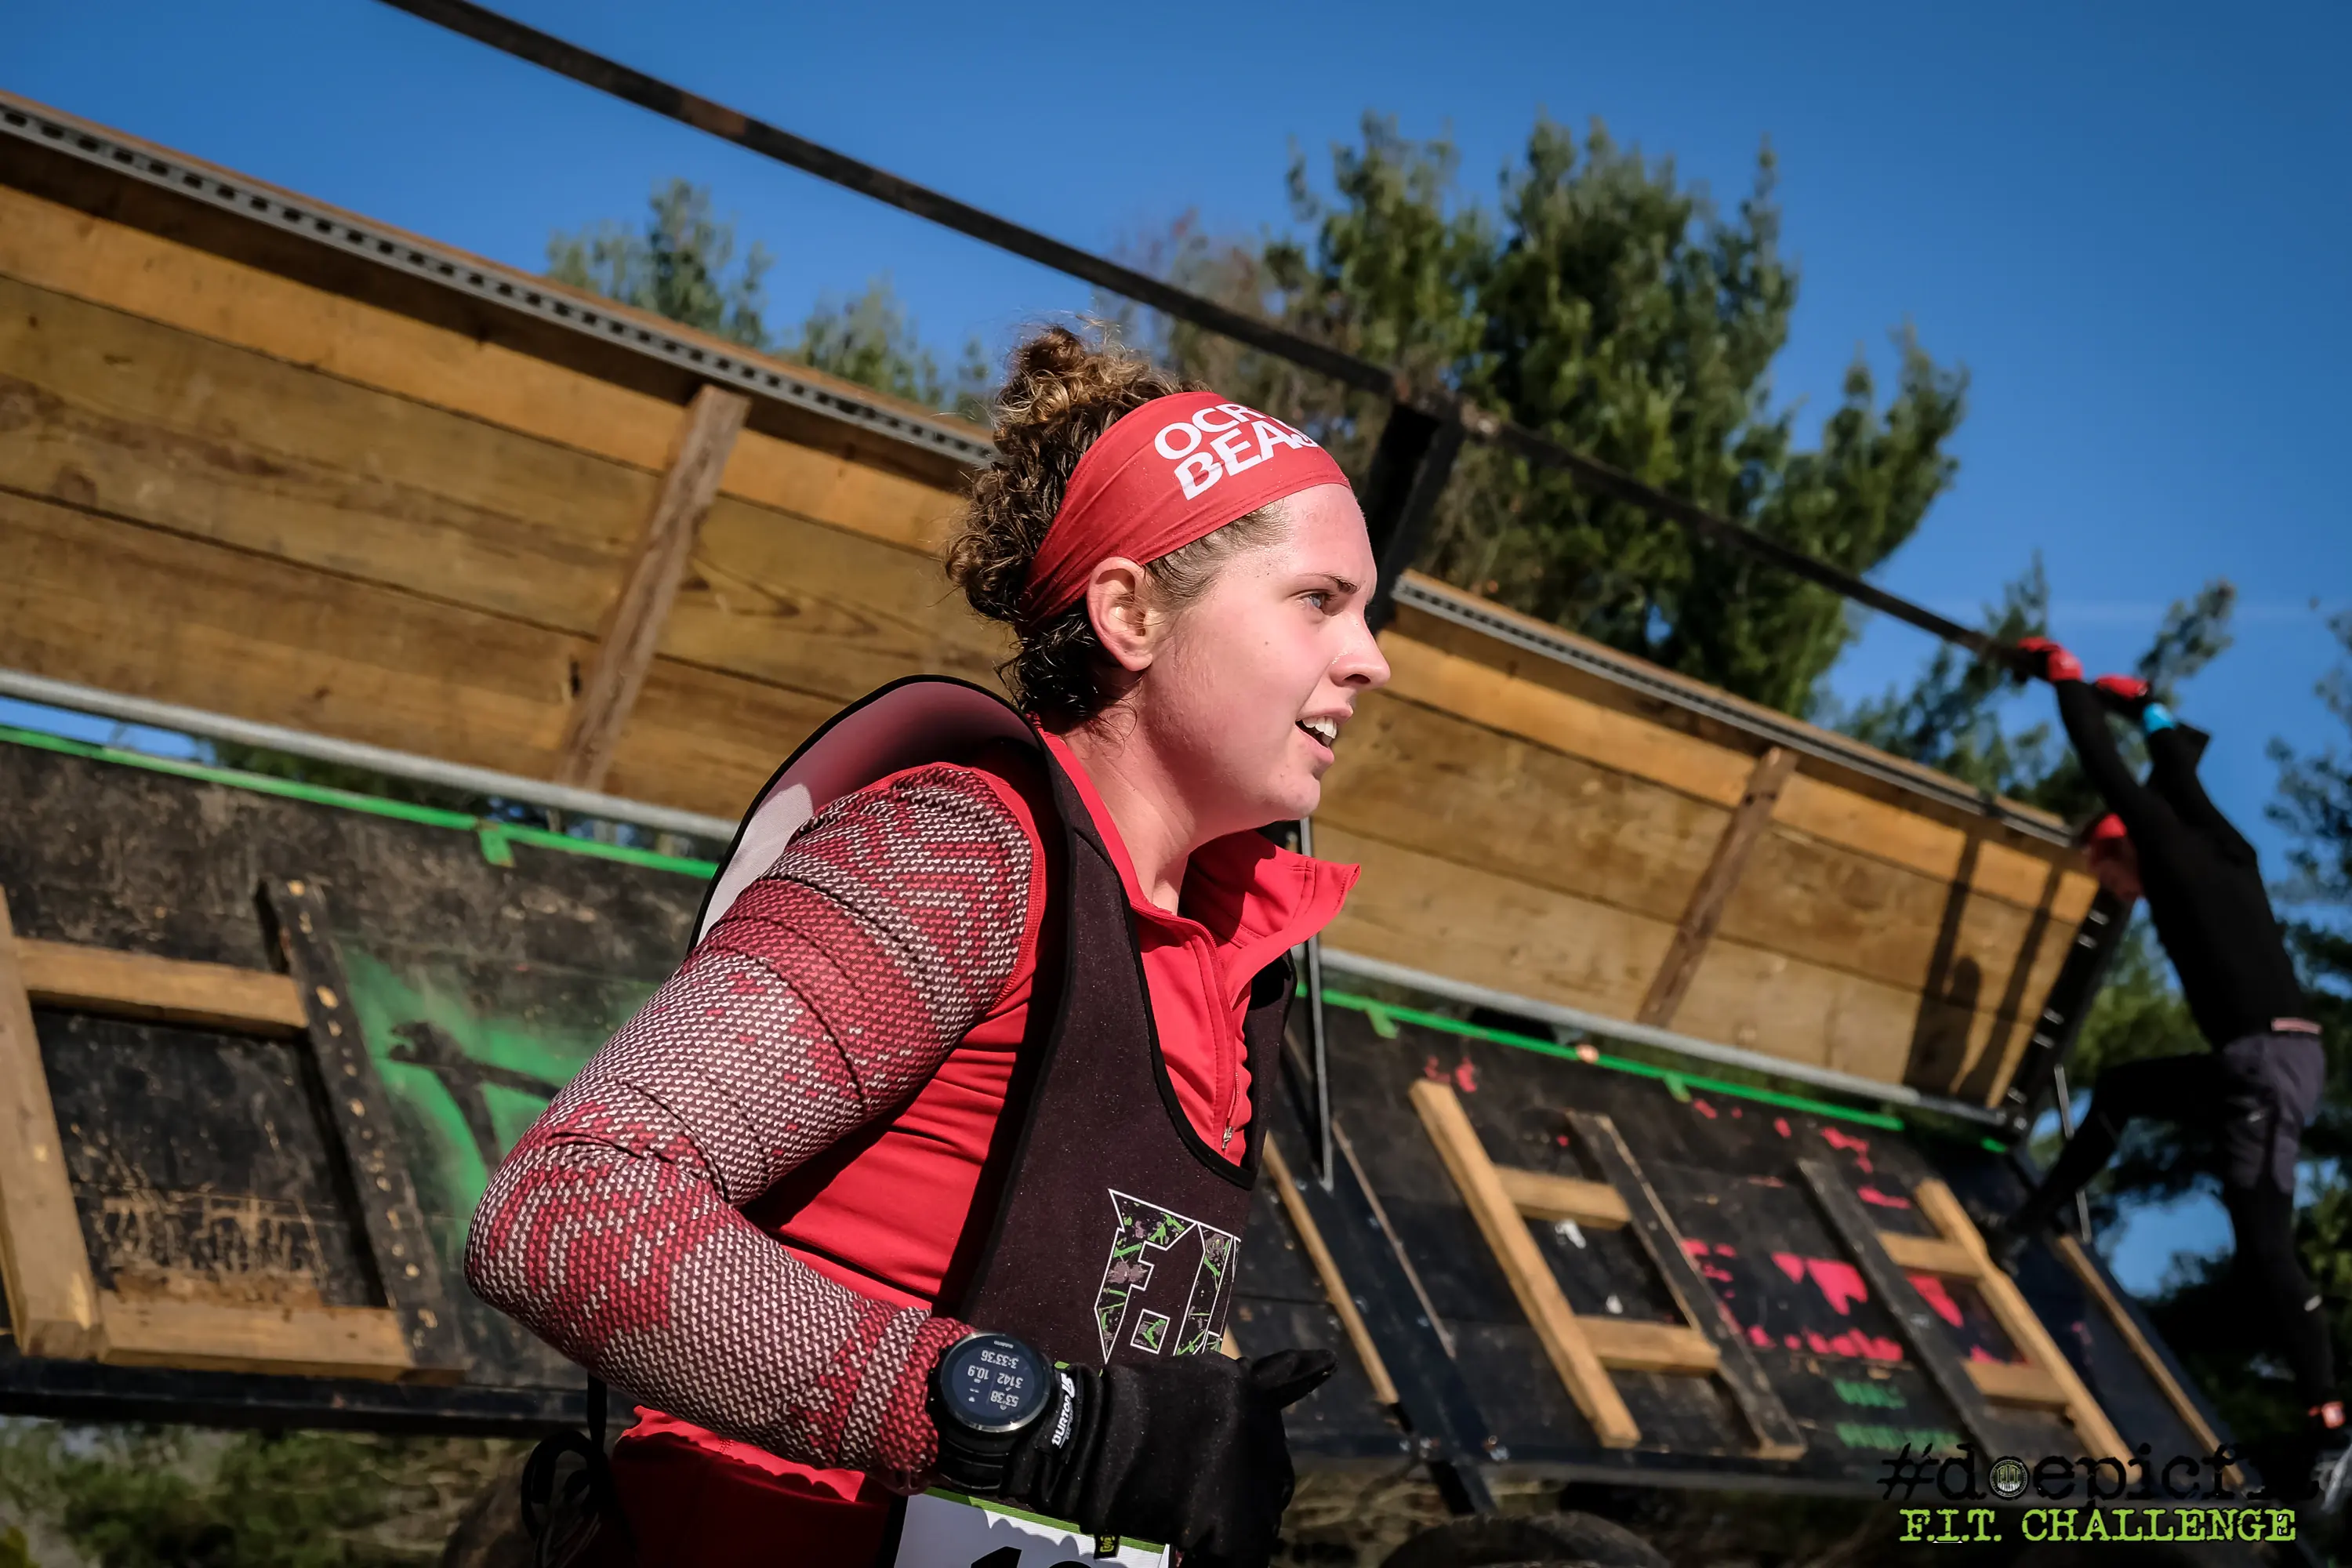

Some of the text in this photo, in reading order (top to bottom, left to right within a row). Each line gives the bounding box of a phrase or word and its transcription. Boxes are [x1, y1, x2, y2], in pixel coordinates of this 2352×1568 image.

[1154, 403, 1267, 460] OCR
[967, 1364, 1024, 1388] 3142 10.9
